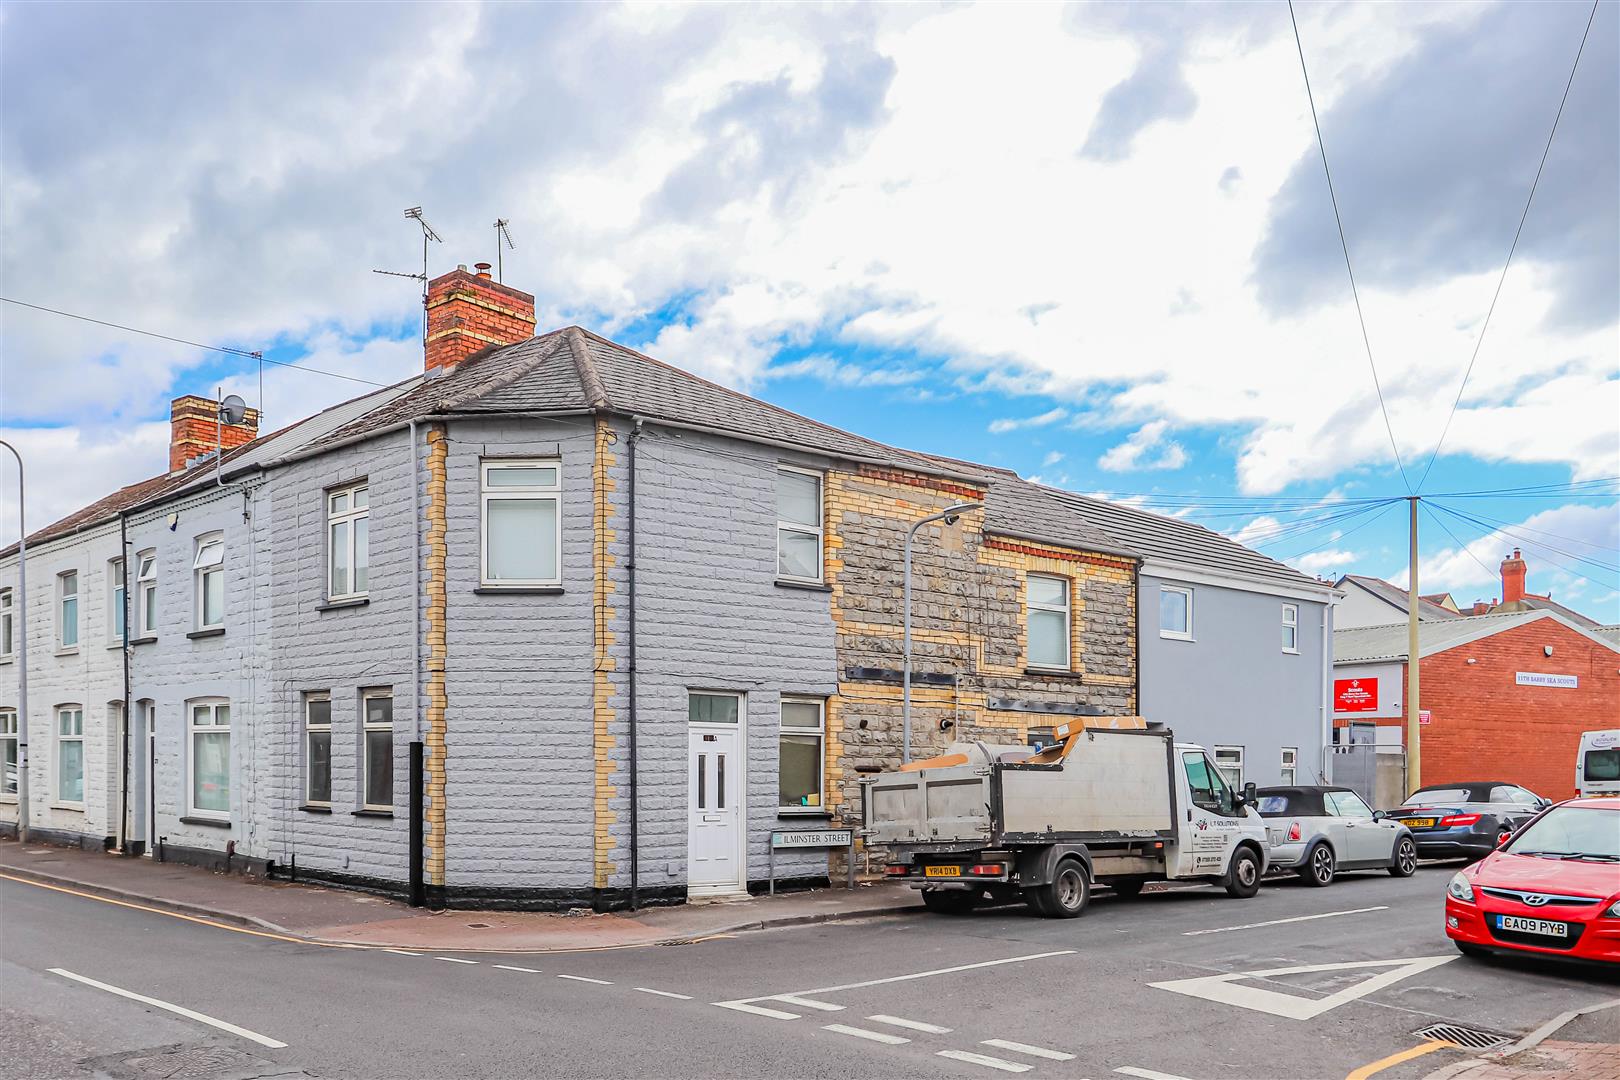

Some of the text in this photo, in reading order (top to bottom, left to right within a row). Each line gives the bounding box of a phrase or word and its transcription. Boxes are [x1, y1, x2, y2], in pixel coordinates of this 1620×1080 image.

[784, 834, 850, 844] ILMINSTER STREET
[928, 866, 956, 875] YR14 DXB
[1540, 922, 1565, 934] PYB
